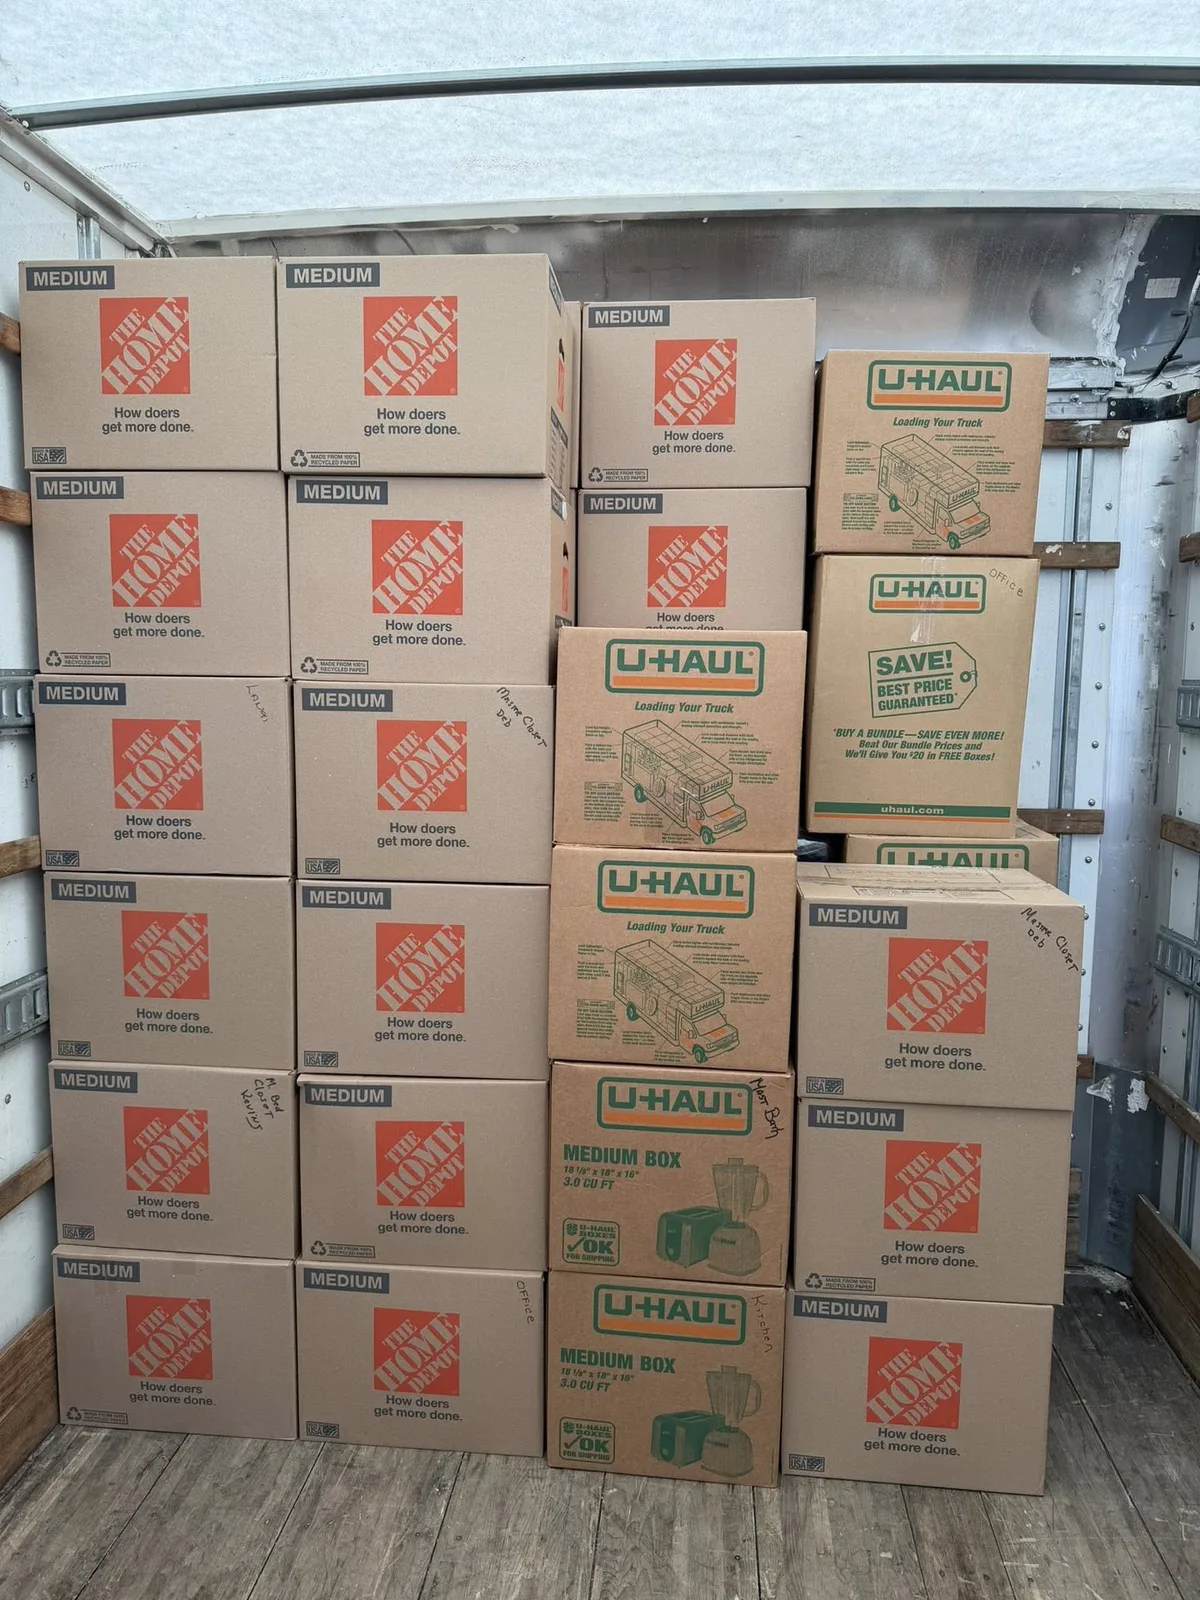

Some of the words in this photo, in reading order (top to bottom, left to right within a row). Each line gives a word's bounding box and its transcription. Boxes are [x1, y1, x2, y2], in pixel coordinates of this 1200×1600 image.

[33, 270, 108, 287] MEDIUM
[293, 267, 372, 284] MEDIUM
[108, 306, 146, 344] THE
[595, 309, 664, 324] MEDIUM
[372, 306, 413, 347] THE
[100, 296, 189, 393] HOME
[363, 296, 458, 396] HOME
[135, 330, 190, 393] DEPOT
[400, 332, 458, 396] DEPOT
[662, 348, 699, 383] THE
[653, 339, 738, 426] HOME
[878, 368, 1002, 393] U-HAUL
[686, 369, 737, 425] DEPOT
[893, 417, 930, 429] Loading
[933, 418, 954, 428] Your
[957, 418, 983, 428] Truck
[34, 451, 49, 463] USA
[43, 480, 117, 496] MEDIUM
[303, 484, 381, 501] MEDIUM
[590, 497, 657, 511] MEDIUM
[655, 534, 690, 567] THE
[646, 526, 728, 608] HOME
[678, 554, 728, 608] DEPOT
[877, 580, 978, 599] U-HAUL
[124, 612, 151, 623] How
[155, 612, 190, 623] doers
[113, 626, 132, 638] get
[135, 628, 167, 636] more
[170, 626, 205, 637] done.
[617, 648, 754, 675] U-HAUL
[876, 649, 953, 676] SAVE!
[45, 686, 119, 701] MEDIUM
[877, 682, 910, 698] BEST
[914, 678, 952, 694] PRICE
[309, 693, 386, 708] MEDIUM
[634, 701, 675, 714] Loading
[678, 702, 702, 713] Your
[705, 703, 734, 714] Truck
[856, 729, 864, 738] A
[944, 730, 969, 740] EVEN
[971, 731, 1005, 741] MORE!
[385, 728, 424, 765] THE
[858, 740, 879, 749] Beat
[881, 740, 898, 749] Our
[900, 740, 932, 749] Bundle
[934, 741, 962, 750] Prices
[964, 742, 983, 751] and
[869, 750, 889, 759] Give
[891, 751, 908, 759] You
[927, 752, 936, 760] in
[938, 752, 961, 761] FREE
[963, 752, 995, 761] Boxes!
[376, 720, 467, 811] HOME
[412, 752, 467, 811] DEPOT
[880, 805, 944, 815] uhaul.com
[47, 855, 62, 865] USA
[307, 862, 323, 873] USA
[58, 883, 130, 899] MEDIUM
[608, 869, 744, 897] U-HAUL
[309, 890, 384, 906] MEDIUM
[817, 908, 899, 925] MEDIUM
[132, 919, 168, 953] THE
[626, 921, 667, 934] Loading
[670, 923, 693, 934] Your
[696, 924, 725, 935] Truck
[124, 913, 207, 997] HOME
[158, 942, 208, 997] DEPOT
[897, 947, 940, 984] THE
[886, 940, 987, 1031] HOME
[926, 971, 987, 1031] DEPOT
[387, 1016, 414, 1027] How
[417, 1017, 452, 1029] doers
[374, 1029, 394, 1042] get
[397, 1032, 429, 1041] more
[432, 1030, 466, 1042] done.
[61, 1073, 131, 1089] MEDIUM
[808, 1081, 825, 1092] USA
[310, 1088, 385, 1103] MEDIUM
[608, 1086, 742, 1115] U-HAUL
[815, 1110, 896, 1127] MEDIUM
[563, 1143, 638, 1166] MEDIUM
[645, 1150, 682, 1169] BOX
[563, 1165, 574, 1174] 18
[563, 1176, 581, 1186] 3.0
[583, 1178, 598, 1189] CU
[600, 1180, 615, 1190] FT
[583, 1239, 614, 1255] OK
[895, 1240, 924, 1252] How
[927, 1242, 964, 1254] doers
[581, 1254, 615, 1263] SHIPPING
[881, 1253, 902, 1266] get
[905, 1255, 939, 1265] more
[942, 1255, 978, 1267] done.
[63, 1262, 134, 1279] MEDIUM
[310, 1273, 383, 1290] MEDIUM
[604, 1293, 737, 1326] U-HAUL
[801, 1300, 880, 1318] MEDIUM
[560, 1347, 633, 1370] MEDIUM
[640, 1355, 676, 1374] BOX
[876, 1348, 917, 1381] THE
[561, 1367, 571, 1376] 18
[560, 1378, 577, 1388] 3.0
[579, 1380, 594, 1391] CU
[596, 1381, 611, 1393] FT
[865, 1342, 962, 1422] HOME
[902, 1373, 961, 1425] DEPOT
[579, 1437, 610, 1454] OK
